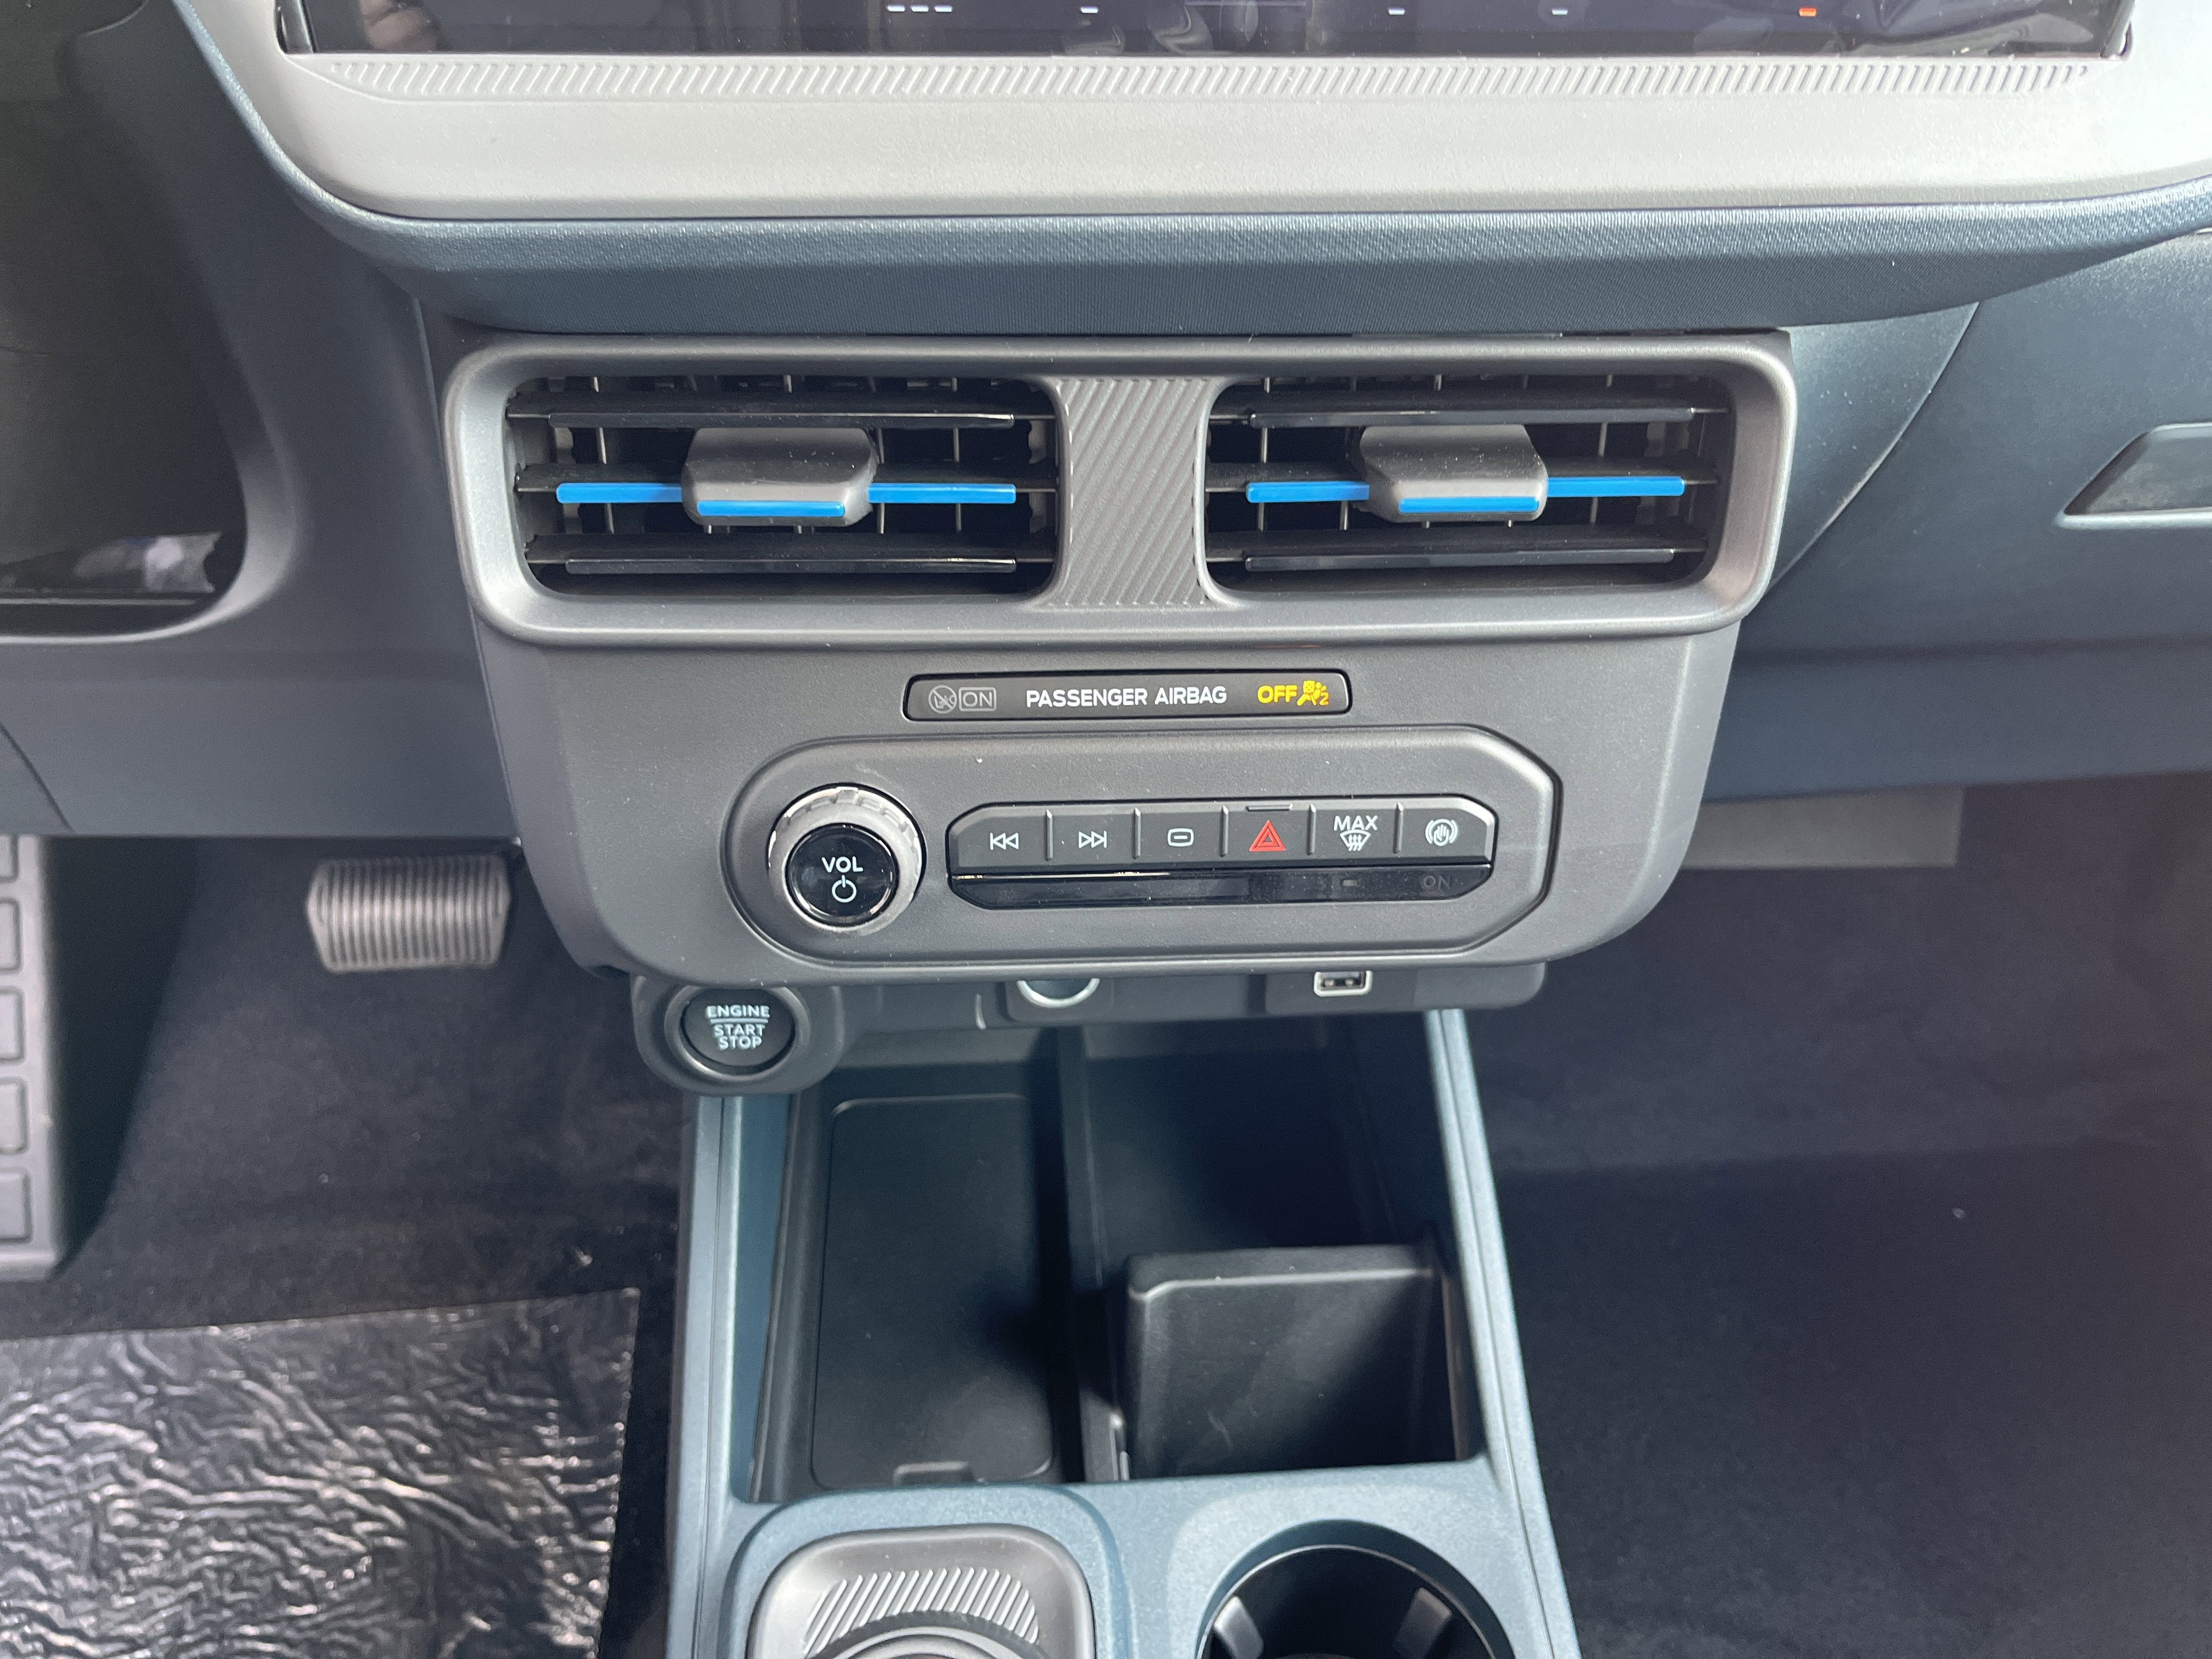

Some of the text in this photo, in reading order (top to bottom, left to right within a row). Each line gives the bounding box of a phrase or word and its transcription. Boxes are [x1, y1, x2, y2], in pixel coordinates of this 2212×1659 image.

[962, 691, 992, 707] ON
[1026, 686, 1227, 708] PASSENGER AIRBAG
[1257, 685, 1298, 703] OFF
[1333, 815, 1378, 831] MAX
[822, 856, 864, 873] VOL
[1423, 875, 1451, 889] ON
[706, 1004, 770, 1018] ENGINE
[714, 1023, 765, 1038] START
[718, 1035, 763, 1050] STOP
